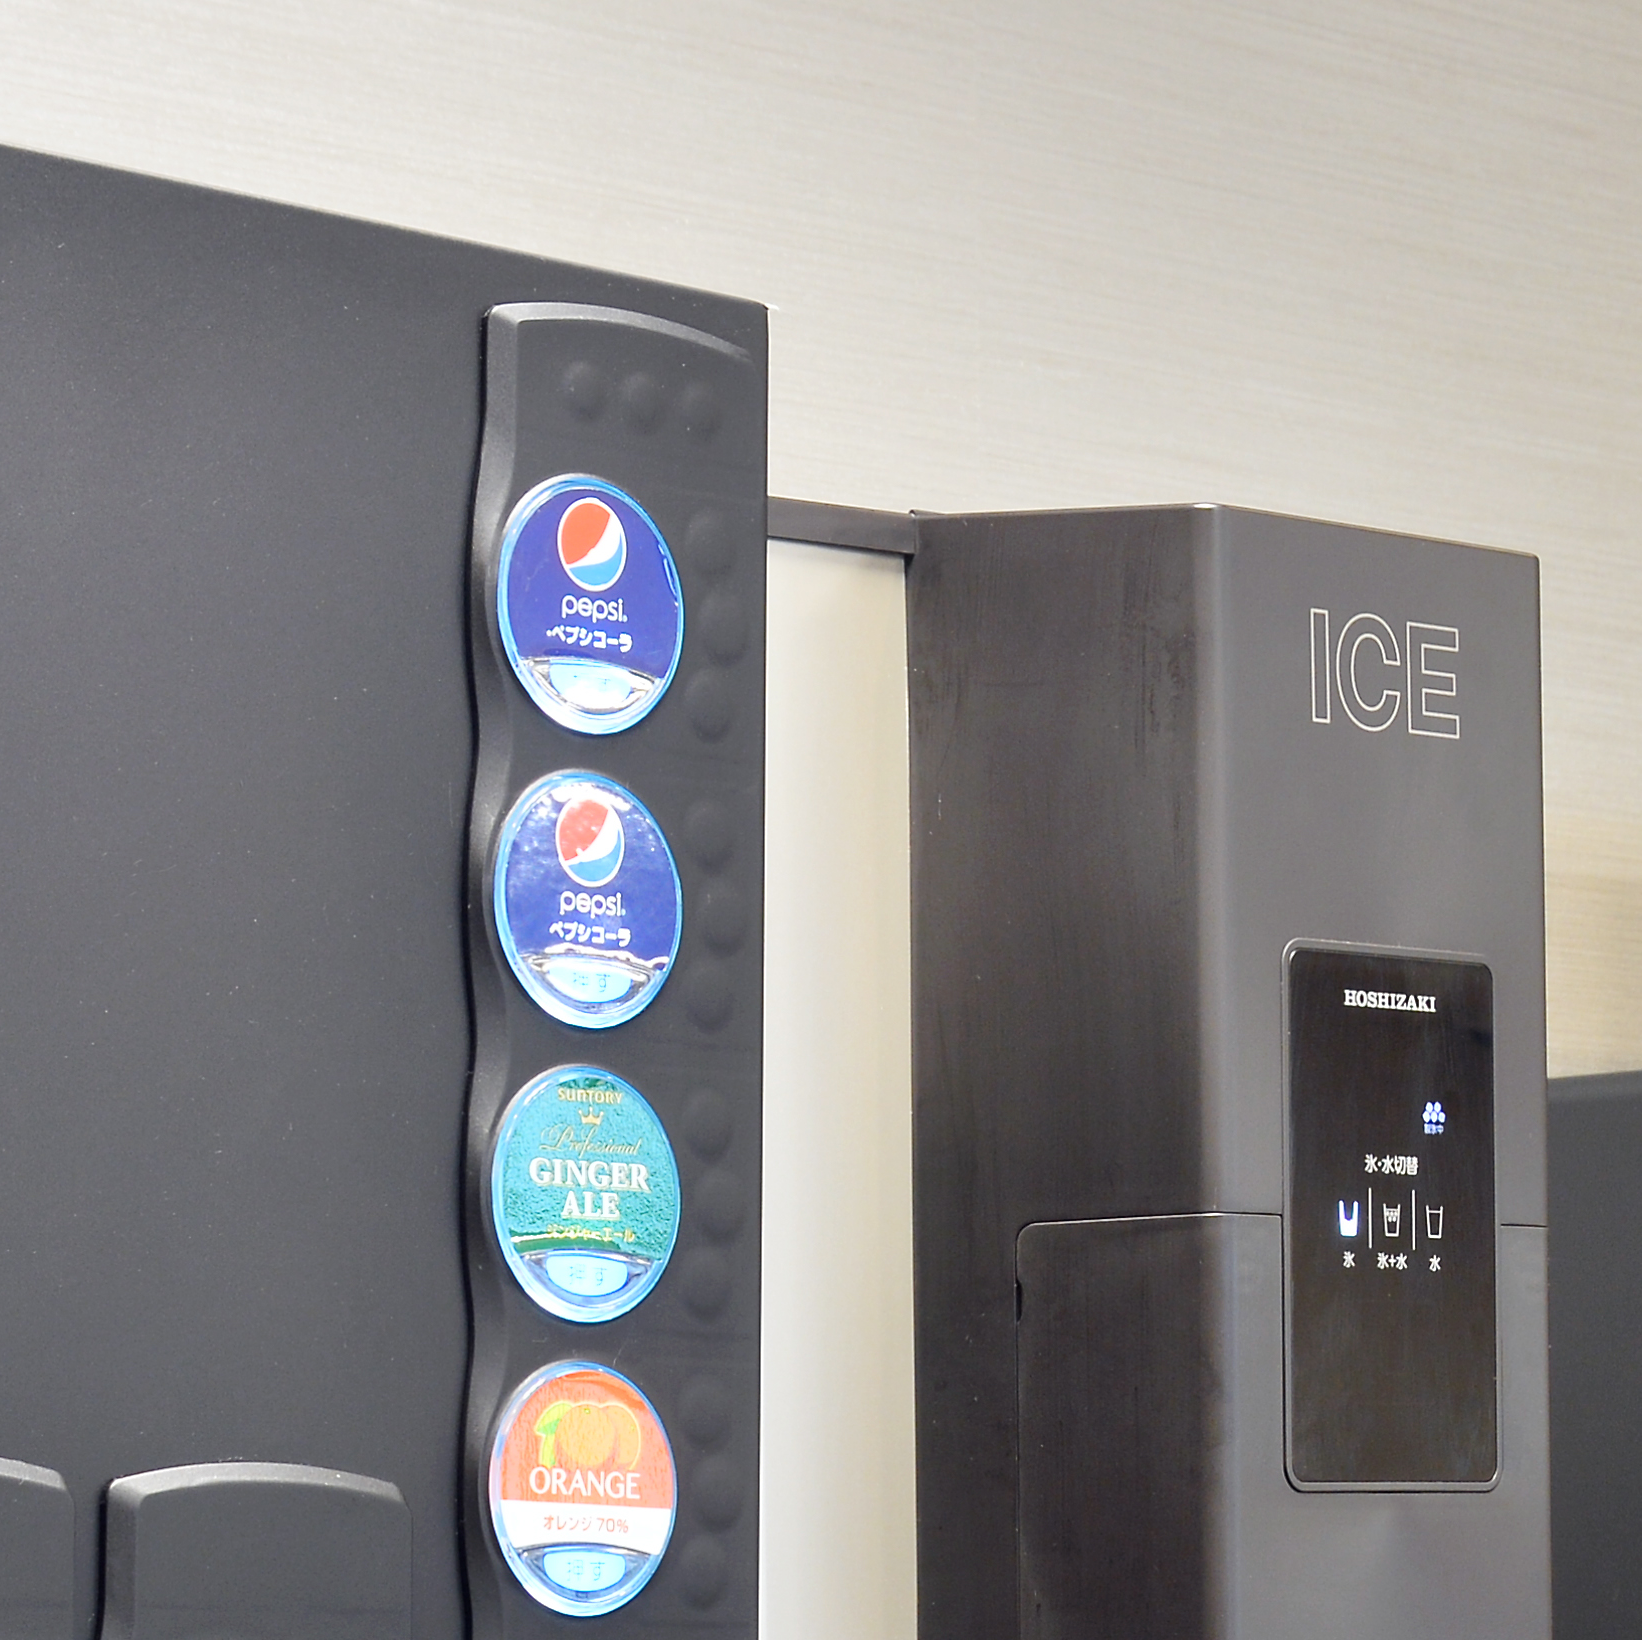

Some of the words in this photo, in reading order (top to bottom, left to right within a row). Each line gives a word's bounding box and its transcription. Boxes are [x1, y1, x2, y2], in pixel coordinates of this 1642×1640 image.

[550, 625, 632, 653] ペプシコーラ
[1310, 607, 1460, 740] ICE
[549, 921, 632, 948] ペプシコーラ
[1343, 989, 1437, 1013] HOSHIZAKI
[540, 1126, 643, 1159] Professional
[529, 1157, 651, 1193] GINGER
[560, 1191, 621, 1220] ALE
[1342, 1251, 1356, 1268] 氷
[1429, 1255, 1442, 1272] 水
[529, 1466, 641, 1499] ORANGE
[544, 1514, 592, 1532] オレンジ
[596, 1516, 629, 1534] 70%
